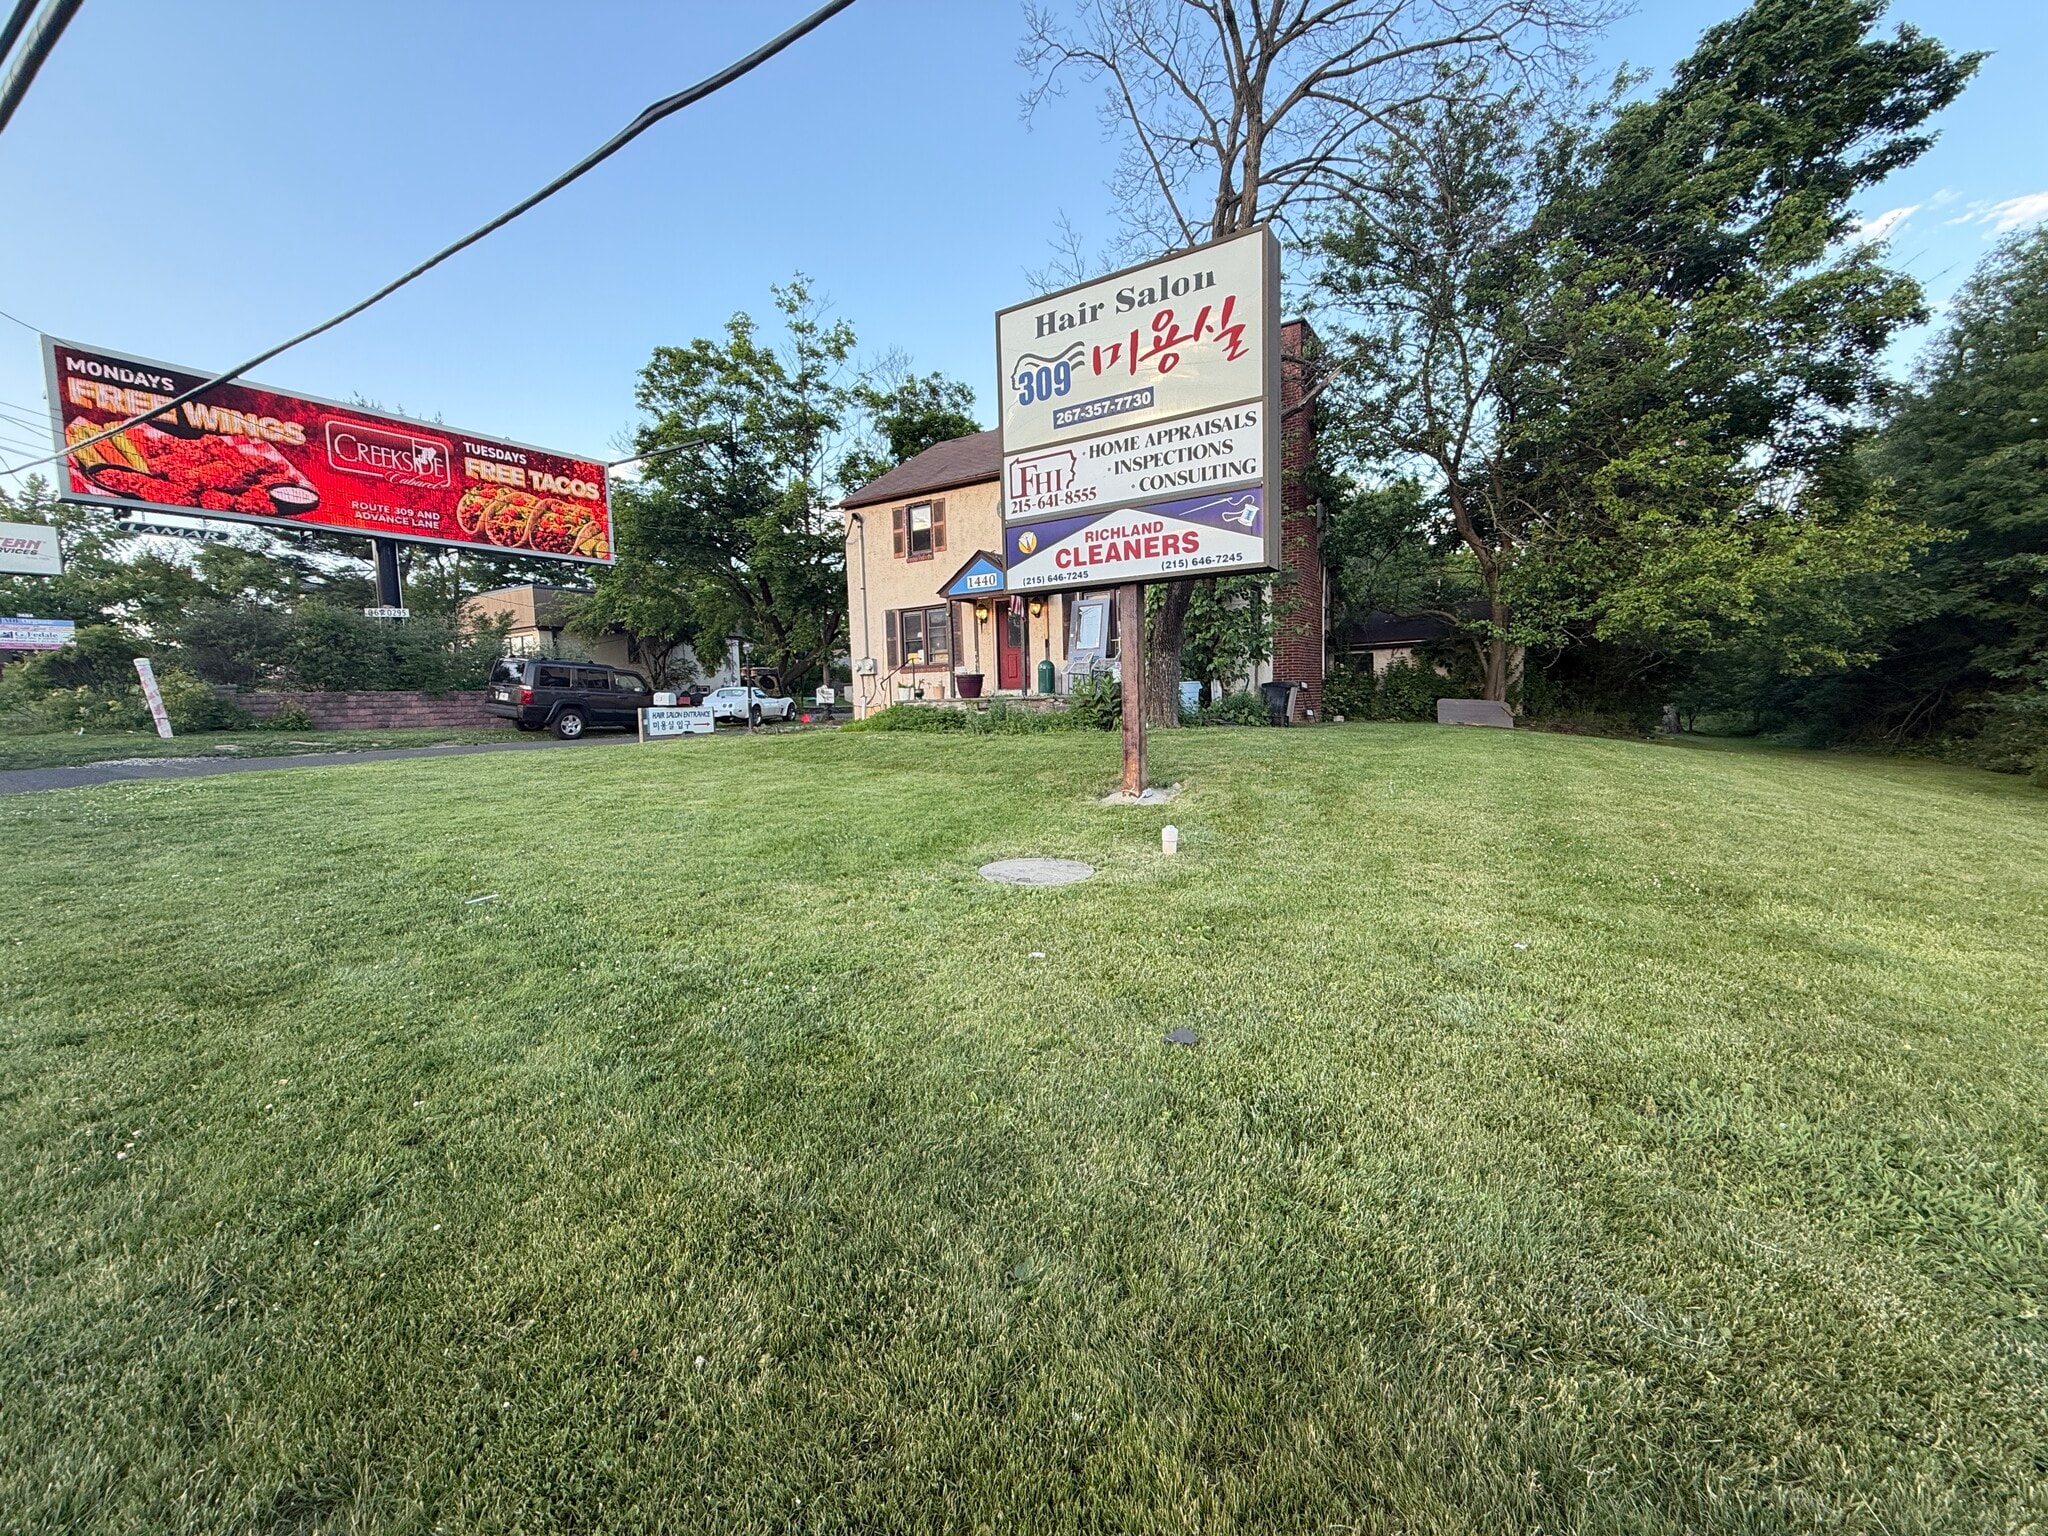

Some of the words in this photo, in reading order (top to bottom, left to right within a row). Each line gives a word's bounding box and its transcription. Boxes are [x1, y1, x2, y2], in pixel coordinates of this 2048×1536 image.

[1035, 301, 1105, 339] Hair
[1115, 270, 1216, 315] Salon
[1092, 295, 1250, 376] 미용실
[66, 356, 176, 392] MONDAYS
[1018, 361, 1072, 406] 309
[67, 376, 178, 426] FREE
[181, 401, 307, 446] WINGS
[1056, 391, 1152, 426] 267-357-7730
[1089, 436, 1140, 459] HOME
[1144, 410, 1258, 449] APPRAISALS
[334, 433, 445, 478] CREEKSIDE
[463, 441, 527, 465] TUESDAYS
[1114, 438, 1234, 475] INSPECTIONS
[464, 456, 527, 489] FREE
[528, 469, 600, 501] TACOS
[1018, 464, 1063, 497] FHI
[1139, 458, 1257, 492] CONSULTING
[351, 501, 390, 514] ROUTE
[394, 507, 414, 517] 309
[417, 510, 440, 520] AND
[1011, 486, 1097, 515] 215-641-8555
[127, 523, 219, 541] LAMAR
[355, 510, 409, 525] ADVANCE
[412, 518, 440, 530] LANE
[1085, 521, 1164, 543] RICHLAND
[1055, 531, 1200, 569] CLEANERS
[1161, 558, 1189, 572] (215)
[1191, 552, 1243, 568] 646-7245
[968, 574, 996, 588] 1440
[1022, 574, 1045, 587] (215)
[1047, 570, 1089, 583] 646-7245
[652, 711, 665, 719] HAIR
[666, 711, 682, 719] SALON
[683, 710, 711, 718] ENTRANCE
